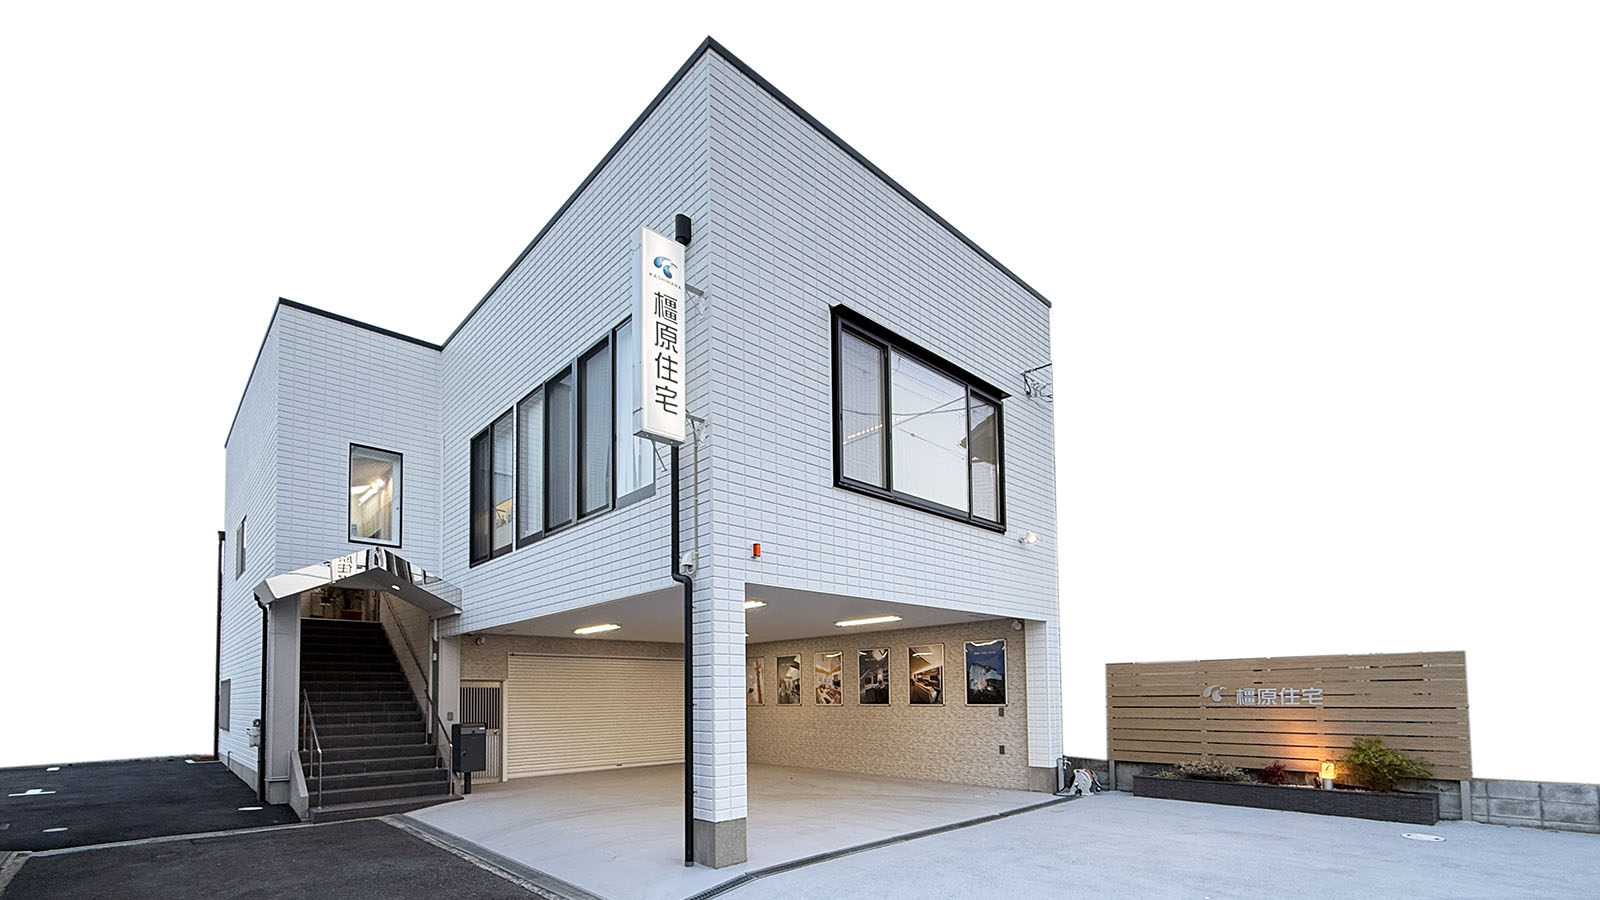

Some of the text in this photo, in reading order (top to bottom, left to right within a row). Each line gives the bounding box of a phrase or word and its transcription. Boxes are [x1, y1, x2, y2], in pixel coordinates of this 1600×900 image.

[654, 291, 678, 415] 橿原住宅
[1236, 687, 1324, 706] 橿原住宅
